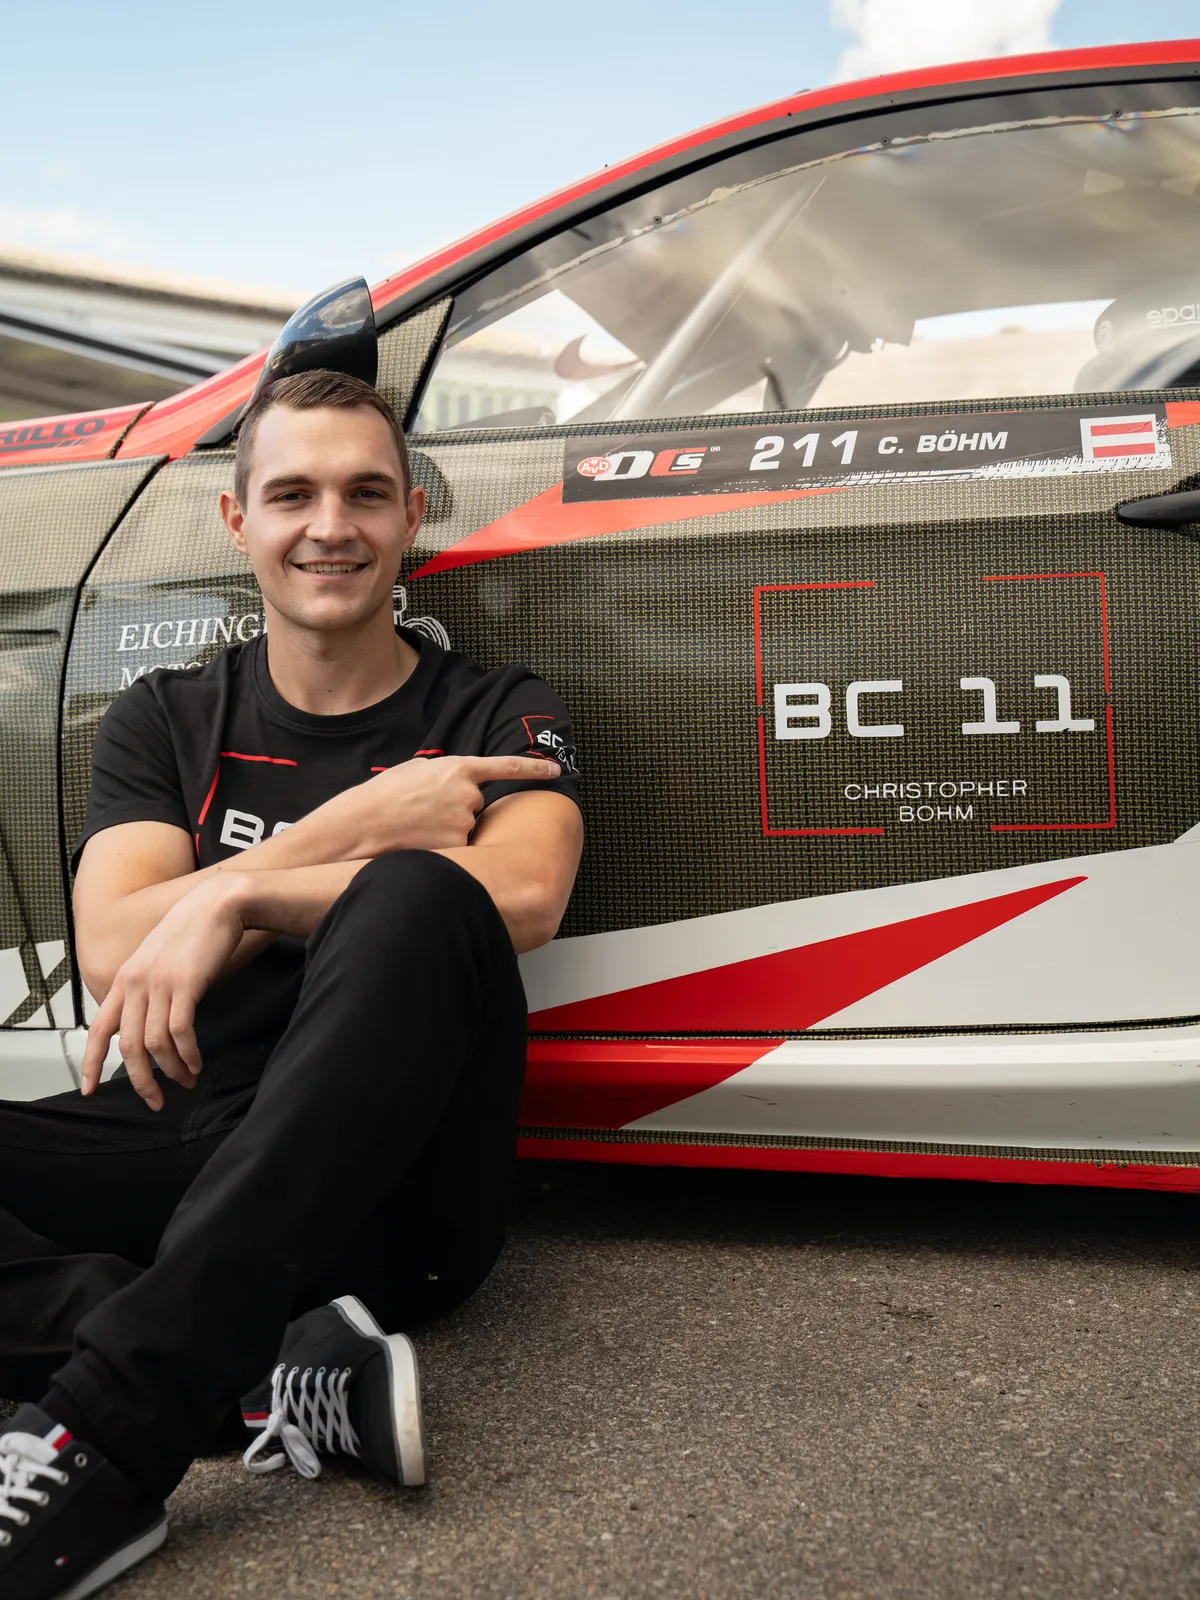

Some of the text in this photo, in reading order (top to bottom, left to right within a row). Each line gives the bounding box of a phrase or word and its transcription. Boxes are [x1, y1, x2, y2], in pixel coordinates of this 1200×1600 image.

[749, 430, 1008, 471] 211 C. BÖHM
[116, 613, 268, 651] EICHING
[774, 674, 1095, 740] BC 11
[844, 779, 1028, 801] CHRISTOPHER
[899, 804, 974, 822] BOHM
